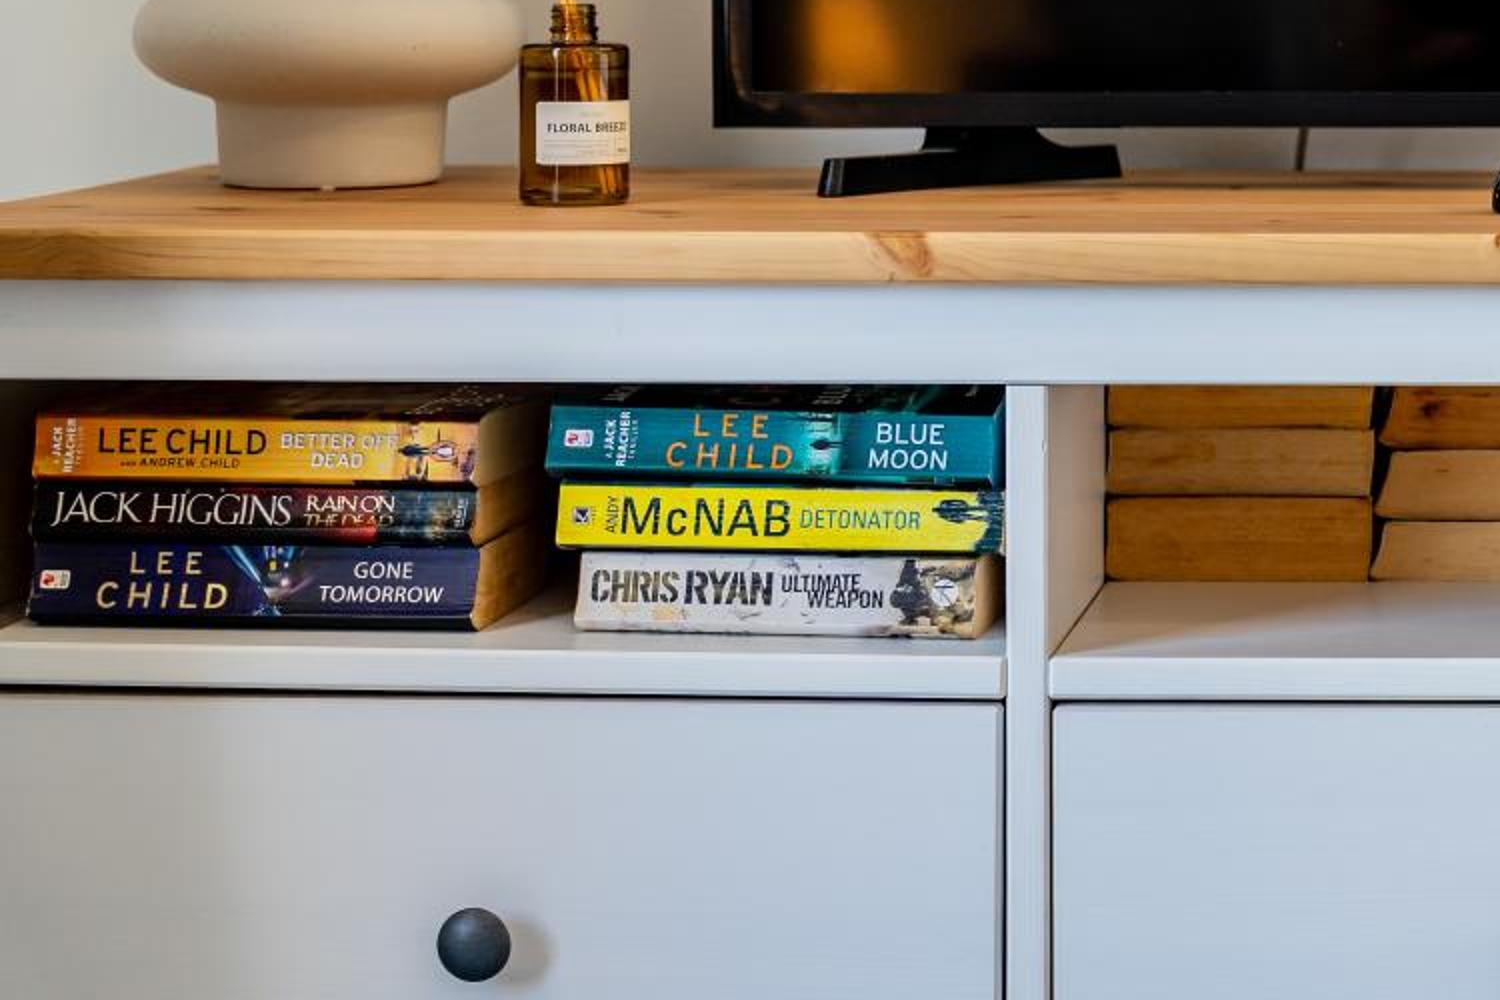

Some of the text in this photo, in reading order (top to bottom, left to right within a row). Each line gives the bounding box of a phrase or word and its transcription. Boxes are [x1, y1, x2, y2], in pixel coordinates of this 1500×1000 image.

[547, 122, 592, 134] FLORAL
[603, 419, 617, 451] JACK
[693, 412, 769, 439] LEE
[876, 422, 945, 445] BLUE
[52, 426, 63, 457] JACK
[98, 427, 159, 454] LEE
[165, 428, 267, 455] CHILD
[281, 431, 400, 451] BETTER OFF
[615, 411, 632, 467] REACHER
[140, 457, 195, 468] ANDREW
[201, 457, 240, 469] CHILD
[311, 452, 365, 469] DEAD
[665, 441, 794, 470] CHILD
[867, 449, 949, 470] MOON
[50, 491, 294, 527] JACK HIGGINS
[306, 494, 395, 512] RAIN ON
[304, 513, 339, 527] THE
[605, 495, 620, 533] ANDY
[620, 496, 791, 537] McNAB
[800, 509, 921, 530] DETONATOR
[130, 551, 203, 575] LEE
[353, 561, 414, 580] GONE
[319, 585, 444, 603] TOMORROW
[590, 569, 774, 606] CHRIS RYAN
[781, 573, 862, 593] ULTIMATE
[95, 581, 229, 609] CHILD
[806, 589, 884, 609] WEAPON
